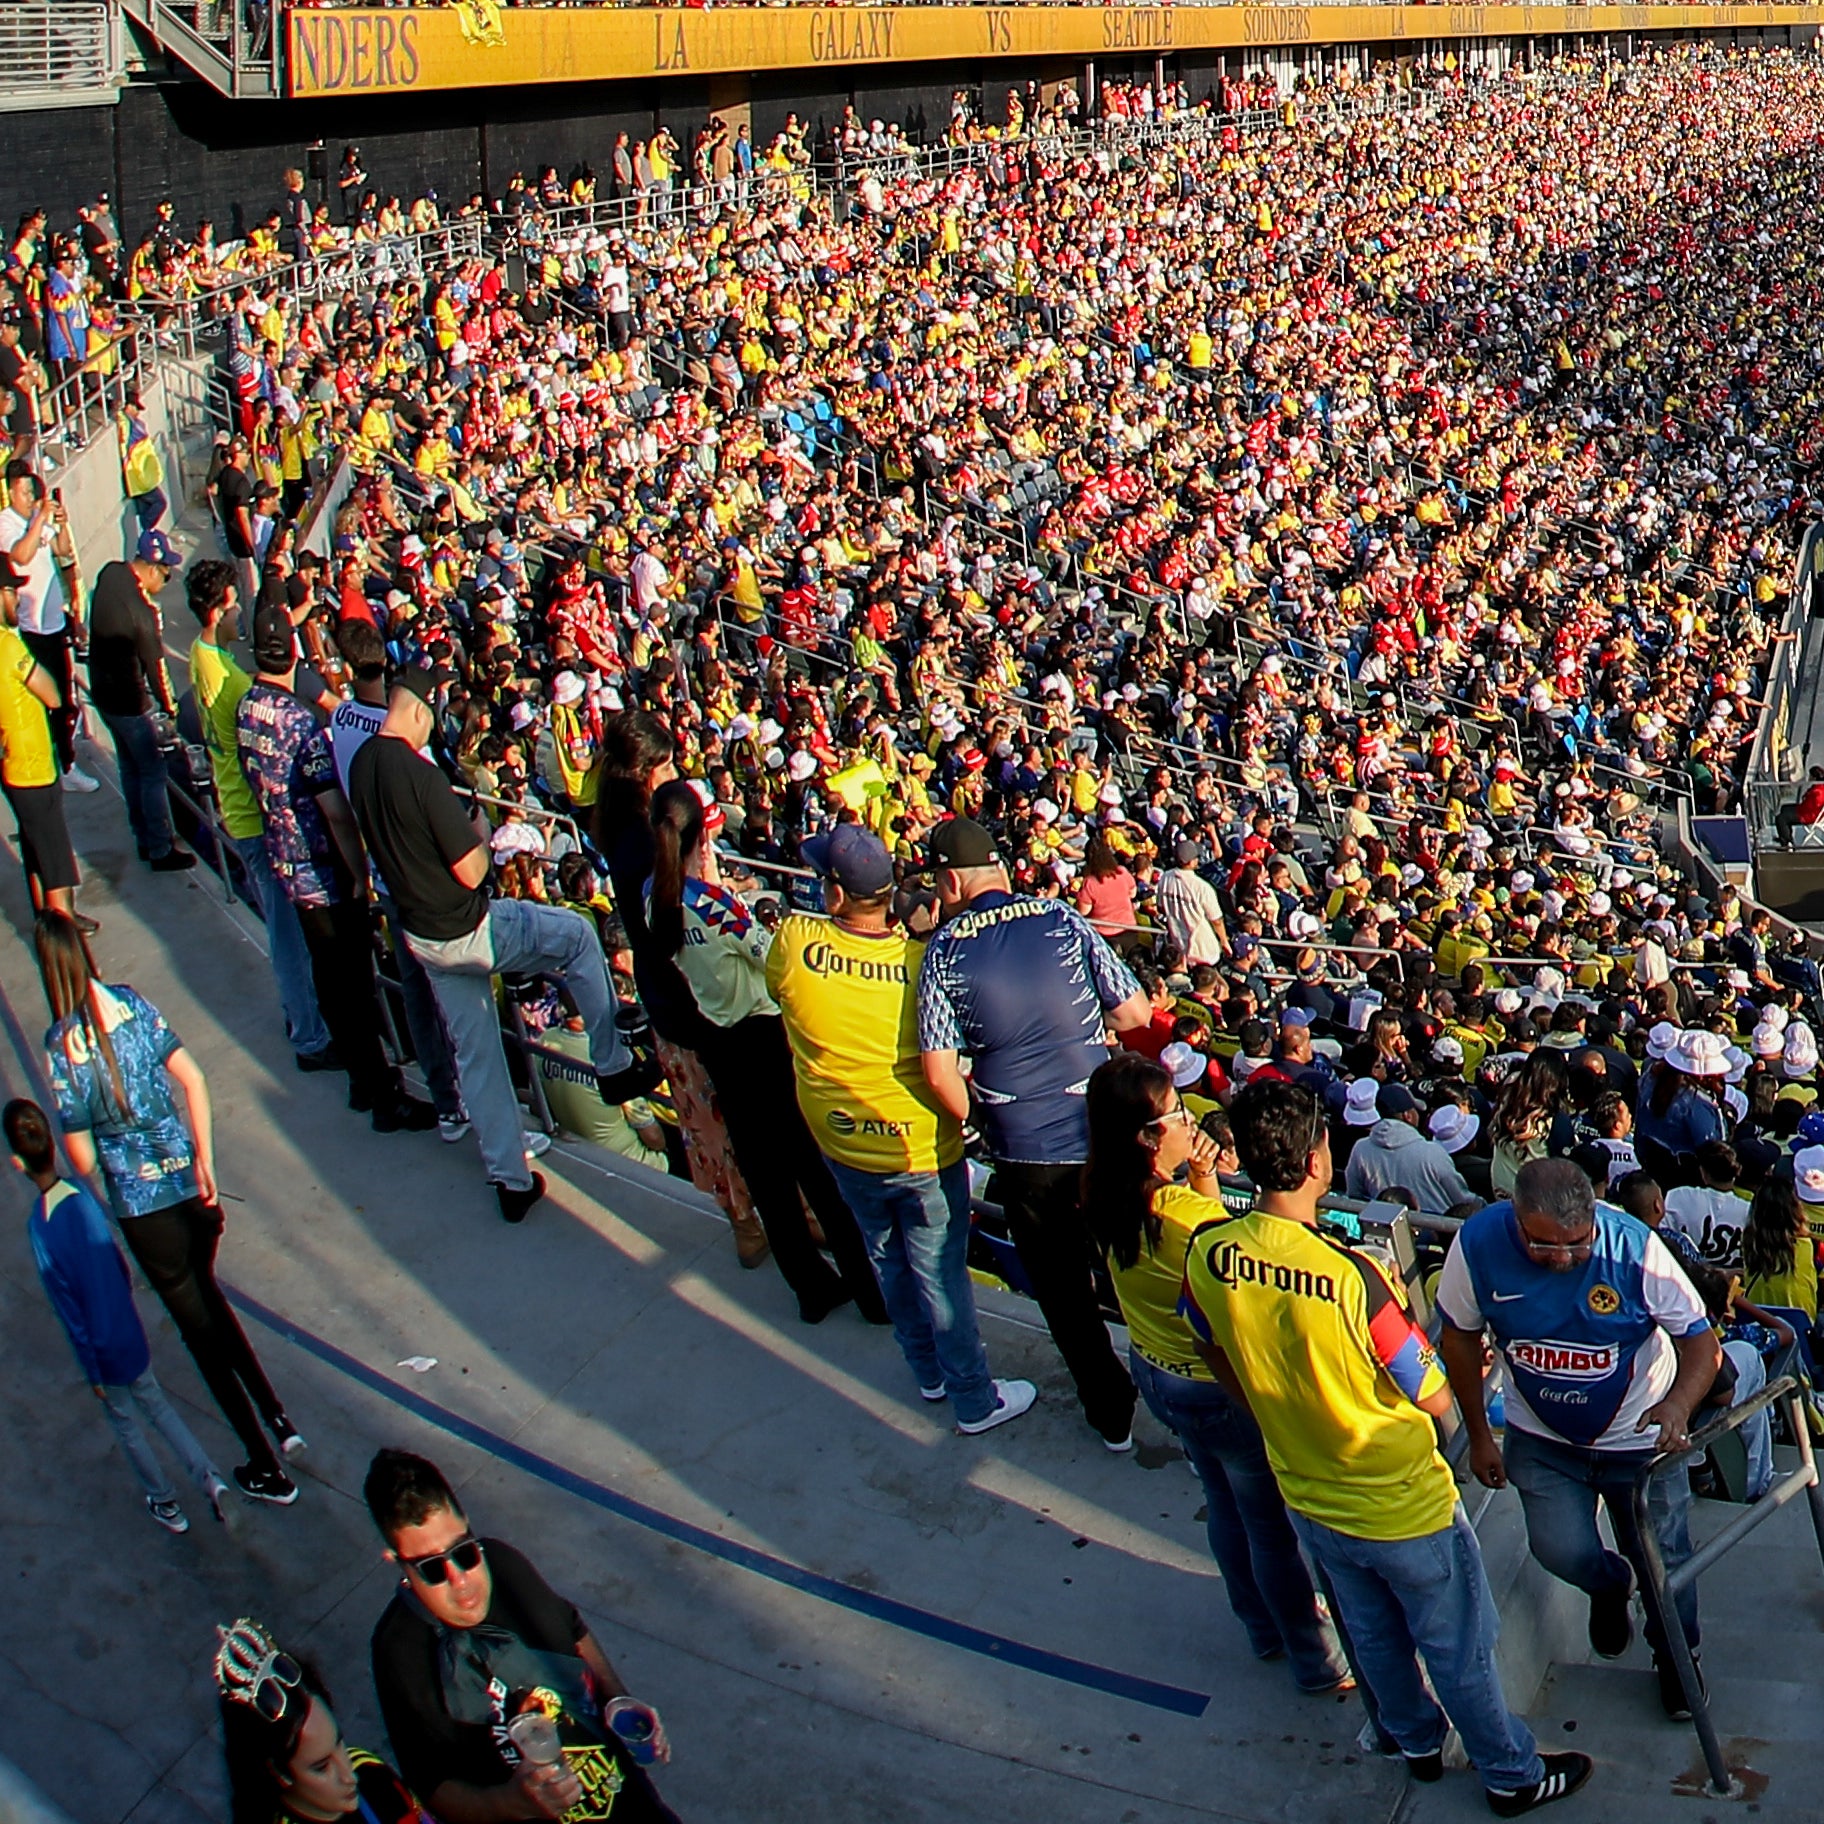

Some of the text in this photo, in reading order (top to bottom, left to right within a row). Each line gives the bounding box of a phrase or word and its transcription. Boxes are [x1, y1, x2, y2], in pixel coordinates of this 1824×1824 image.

[293, 14, 420, 90] NDERS
[655, 12, 690, 70] LA
[810, 10, 896, 62] GALAXY
[987, 10, 1012, 52] VS
[1103, 9, 1174, 48] SEATTLE
[1243, 8, 1312, 42] SOUNDERS
[1392, 7, 1405, 36] LA
[1449, 7, 1485, 34] GALAXY
[951, 901, 1047, 939] Corona
[803, 941, 908, 985] Corona
[862, 1119, 913, 1137] AT&T
[1206, 1239, 1337, 1304] Corona
[1516, 1344, 1612, 1371] BIMBO
[1539, 1386, 1589, 1406] Coca-Cola
